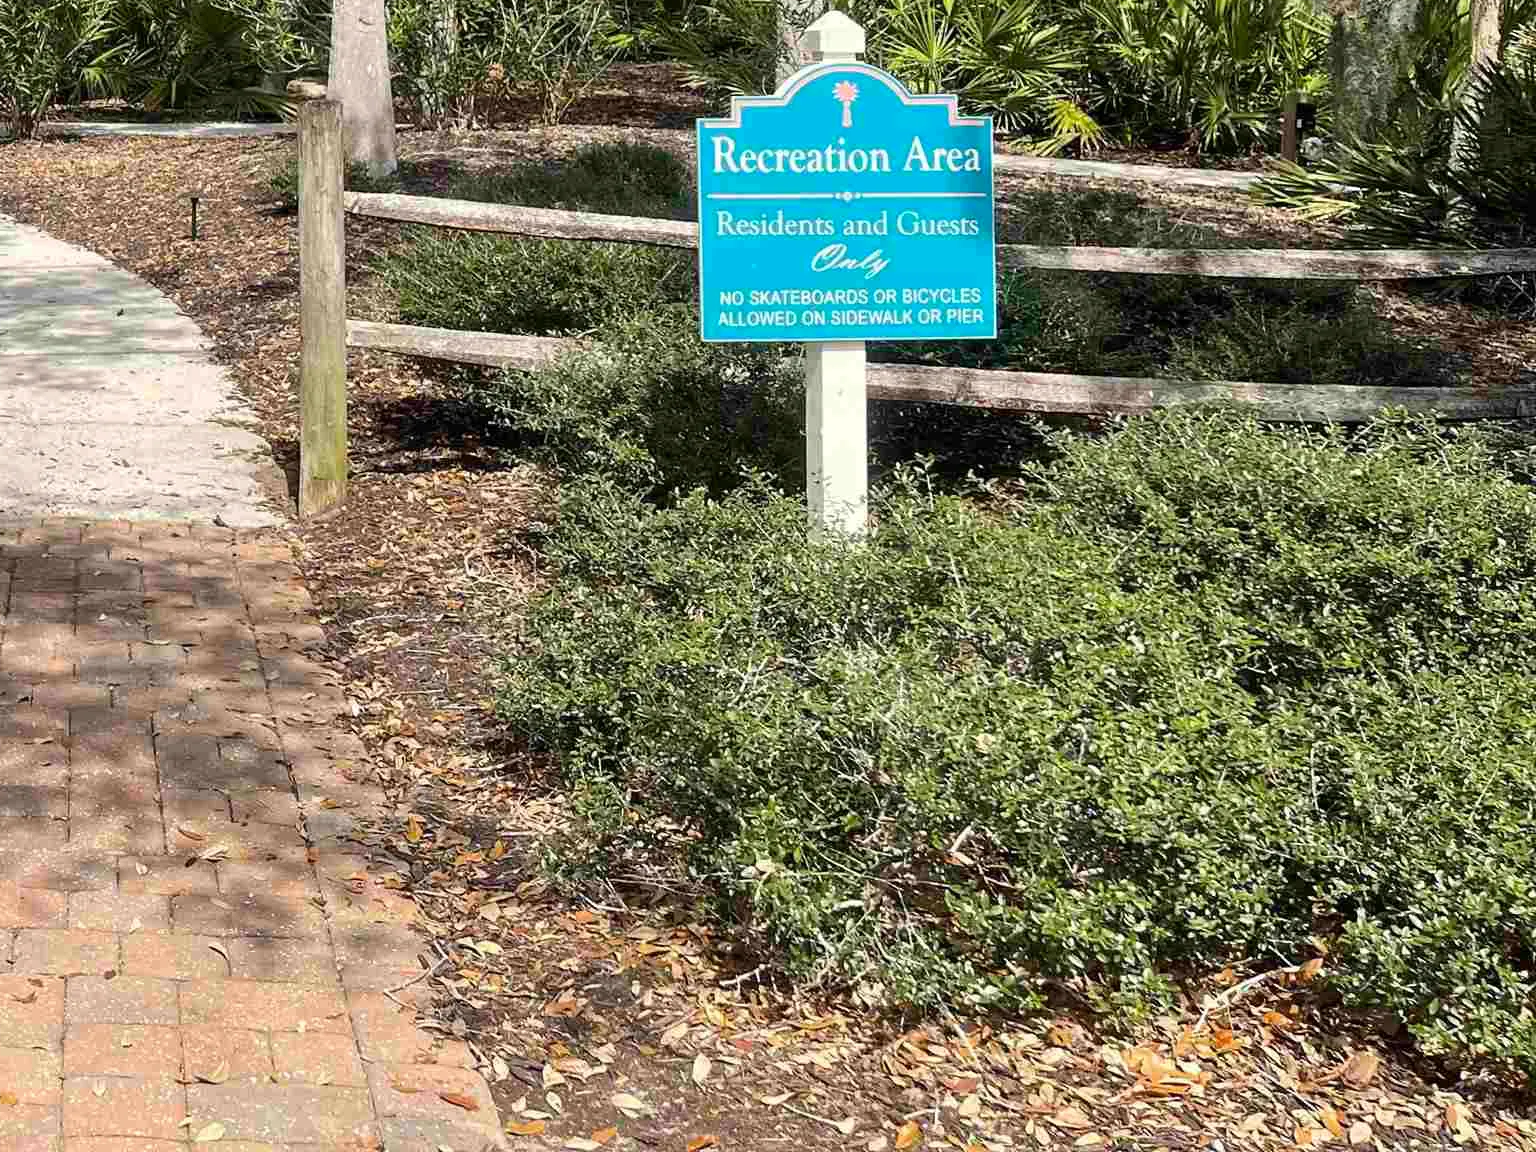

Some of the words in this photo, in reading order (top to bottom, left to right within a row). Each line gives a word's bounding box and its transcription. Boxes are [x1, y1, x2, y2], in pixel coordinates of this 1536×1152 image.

[711, 136, 891, 174] Recreation
[903, 135, 981, 172] Area
[716, 210, 834, 236] Residents
[843, 210, 888, 236] and
[896, 211, 979, 236] Guests
[810, 243, 891, 280] Only
[719, 291, 744, 305] NO
[749, 290, 869, 305] SKATEBOARDS
[873, 289, 897, 305] OR
[902, 288, 981, 304] BICYCLES
[718, 310, 796, 327] ALLOWED
[801, 310, 826, 326] ON
[831, 309, 913, 325] SIDEWALK
[917, 309, 942, 324] OR
[946, 309, 984, 324] PIER
